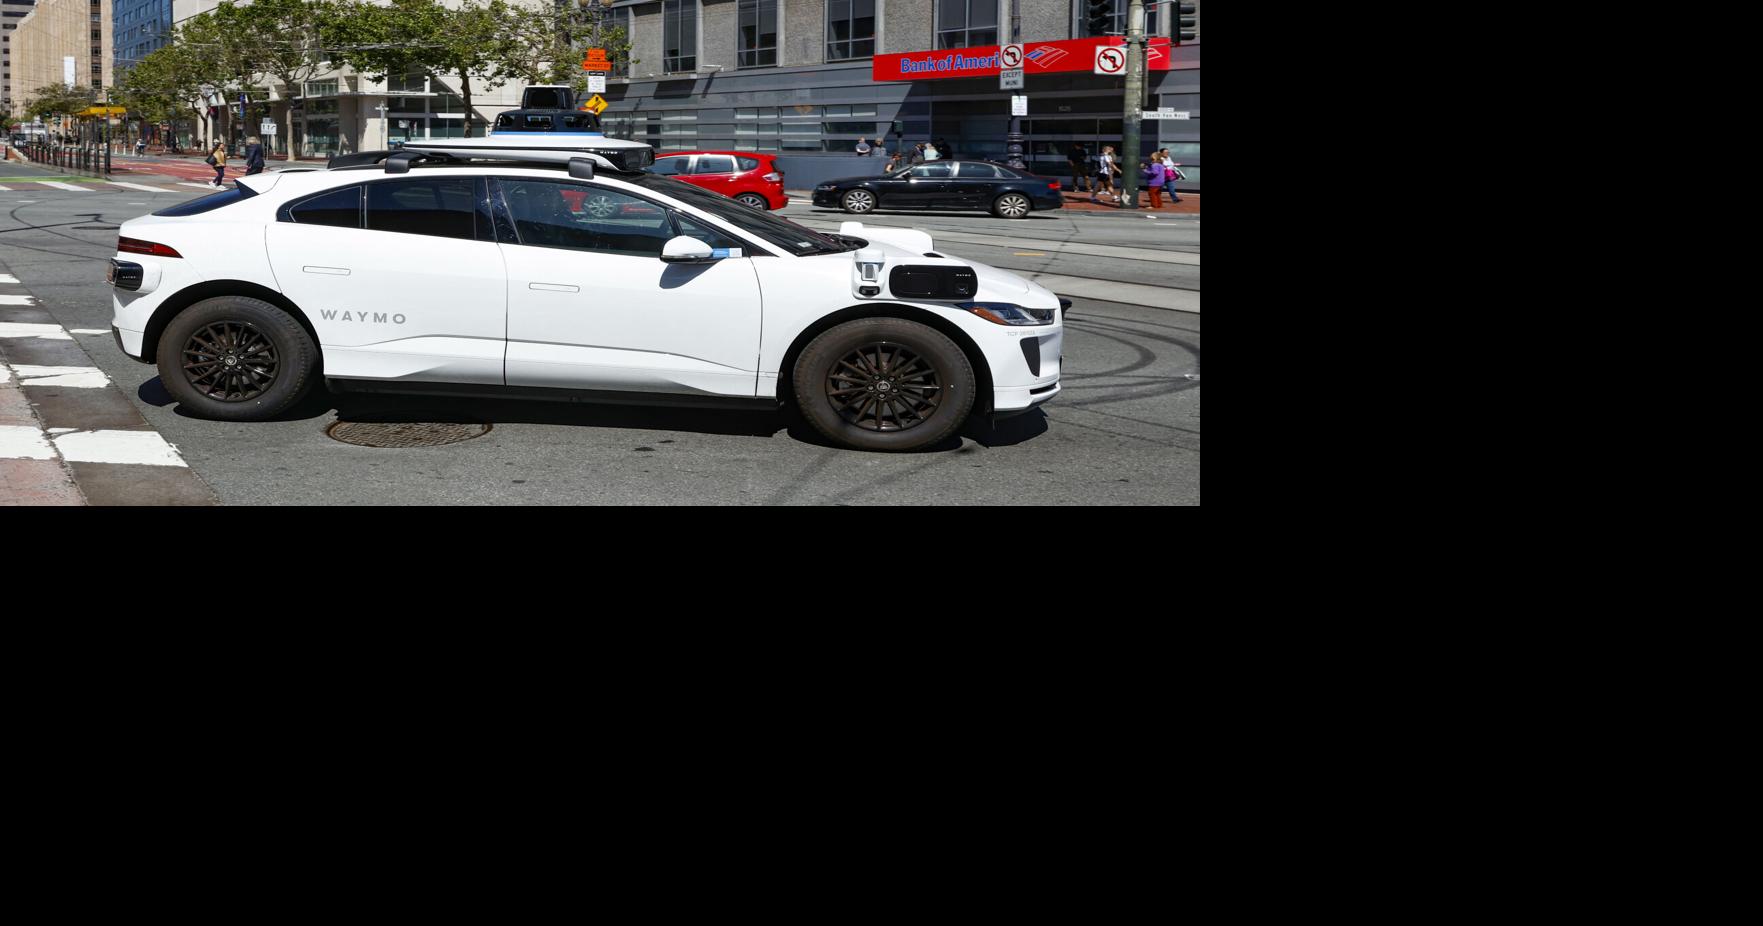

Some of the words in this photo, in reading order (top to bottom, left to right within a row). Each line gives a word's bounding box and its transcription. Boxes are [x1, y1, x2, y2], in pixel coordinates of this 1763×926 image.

[901, 57, 935, 73] Bank
[937, 54, 953, 71] of
[954, 52, 999, 70] Ameri
[320, 309, 406, 324] WAYMO
